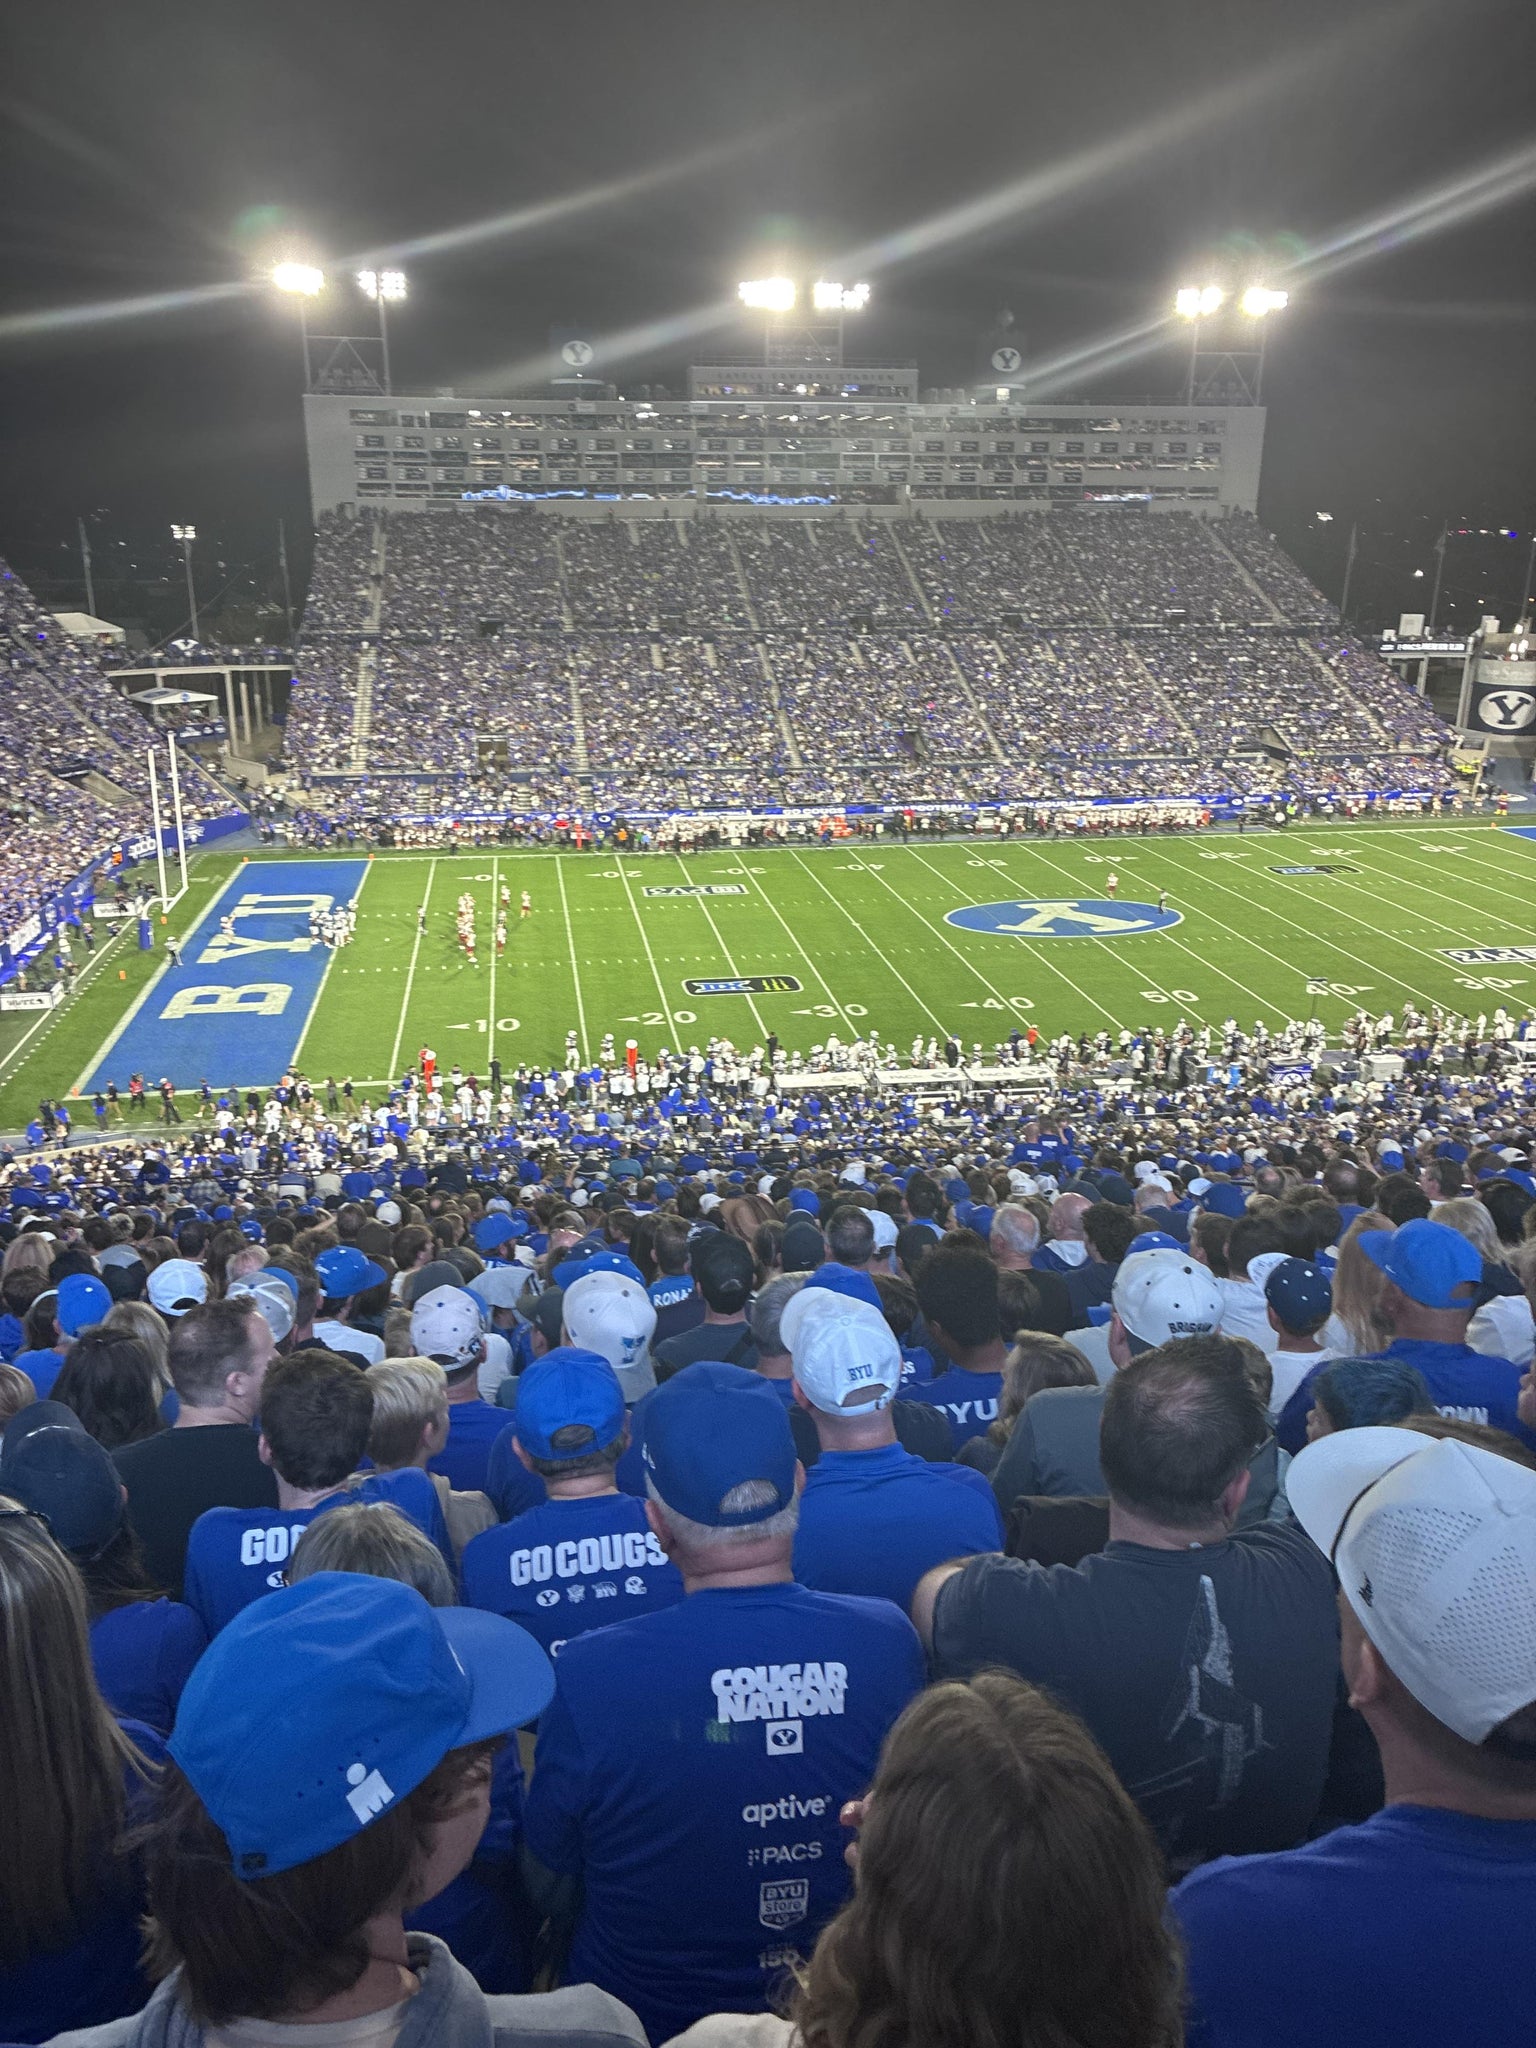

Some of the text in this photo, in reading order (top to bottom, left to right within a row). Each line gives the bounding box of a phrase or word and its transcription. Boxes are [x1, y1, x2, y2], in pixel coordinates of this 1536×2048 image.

[1488, 695, 1531, 725] Y
[158, 893, 335, 1020] BYU
[1305, 981, 1358, 997] 40
[1453, 976, 1513, 990] 30
[977, 996, 1036, 1010] 40
[1139, 989, 1199, 1003] 50
[641, 1010, 698, 1026] 20
[812, 1003, 869, 1018] 30
[475, 1017, 521, 1033] 10
[848, 1363, 874, 1380] BYU
[935, 1398, 999, 1425] YU
[240, 1526, 289, 1566] GO
[509, 1531, 669, 1587] GO COUGS
[710, 1661, 848, 1698] COUGAR
[717, 1688, 845, 1723] NATION
[762, 1841, 823, 1864] PACS
[765, 1884, 802, 1899] BYU
[765, 1901, 802, 1913] store
